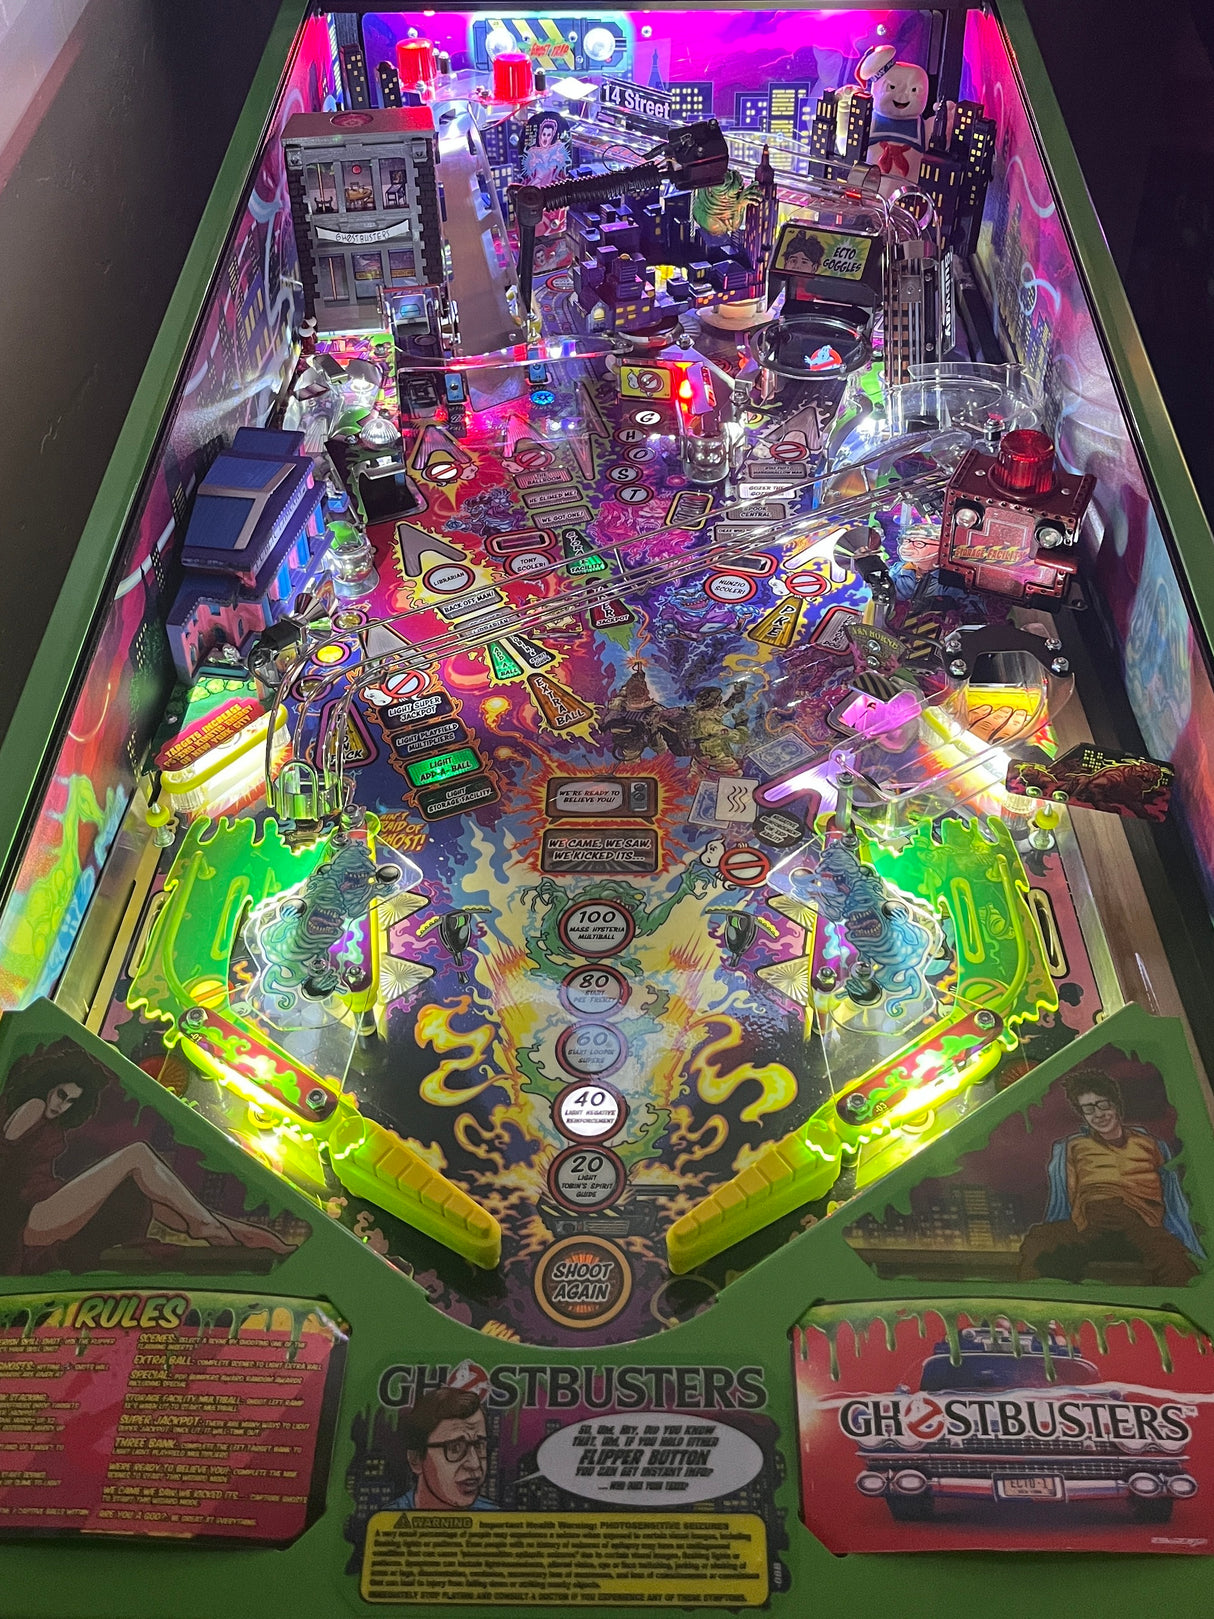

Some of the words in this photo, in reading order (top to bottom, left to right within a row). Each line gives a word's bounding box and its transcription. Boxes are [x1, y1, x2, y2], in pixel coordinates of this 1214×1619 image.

[604, 84, 620, 105] 14
[624, 89, 670, 120] Street
[832, 247, 857, 260] ECTO
[822, 258, 862, 273] GOGGLES
[567, 511, 584, 519] ONE!
[955, 547, 986, 559] STORAGE
[517, 562, 546, 573] SCOLERI
[520, 557, 537, 565] TONY
[433, 571, 465, 587] LIBRARIAN
[719, 579, 746, 588] NUNZIO
[714, 586, 746, 595] SCOLERI
[443, 603, 462, 614] BACK
[477, 590, 496, 603] MAN!
[596, 614, 630, 626] JACKPOT
[767, 604, 796, 637] PKE
[500, 668, 521, 677] BALL
[535, 676, 567, 714] EXTRA
[388, 705, 412, 717] LIGHT
[413, 696, 442, 708] SUPER
[400, 704, 437, 722] JACKPOT
[224, 704, 254, 727] ENERGY
[556, 709, 586, 727] BALL
[164, 731, 202, 758] TARGETS
[201, 703, 242, 733] INCREASE
[191, 742, 211, 758] NEW
[211, 728, 234, 743] YORK
[233, 714, 252, 729] CITY
[396, 734, 418, 747] LIGHT
[419, 723, 459, 740] PLAYFIELD
[407, 733, 455, 752] MULTIPLIERS
[330, 750, 363, 765] PCK
[429, 757, 452, 769] LIGHT
[451, 761, 472, 773] BALL
[427, 795, 461, 814] STORAGE
[460, 788, 492, 803] FACILITY
[446, 788, 466, 799] LIGHT
[406, 823, 426, 834] OF
[548, 839, 567, 849] WE
[567, 839, 602, 849] CAME,
[605, 839, 624, 849] WE
[624, 839, 651, 849] SAW,
[553, 851, 572, 861] WE
[572, 851, 614, 861] KICKED
[615, 851, 645, 861] ITS...
[579, 910, 616, 924] 100
[579, 974, 609, 989] 80
[576, 1031, 609, 1047] 60
[574, 1091, 606, 1107] 40
[570, 1155, 604, 1173] 20
[553, 1261, 614, 1281] SHOOT
[553, 1282, 611, 1301] AGAIN
[75, 1295, 188, 1329] RULES
[134, 1355, 167, 1365] EXTRA
[121, 1414, 152, 1425] SUPER
[115, 1437, 147, 1448] THREE
[579, 1449, 645, 1466] FLIPPER
[648, 1449, 711, 1466] BUTTON
[412, 1517, 472, 1529] WARNING
